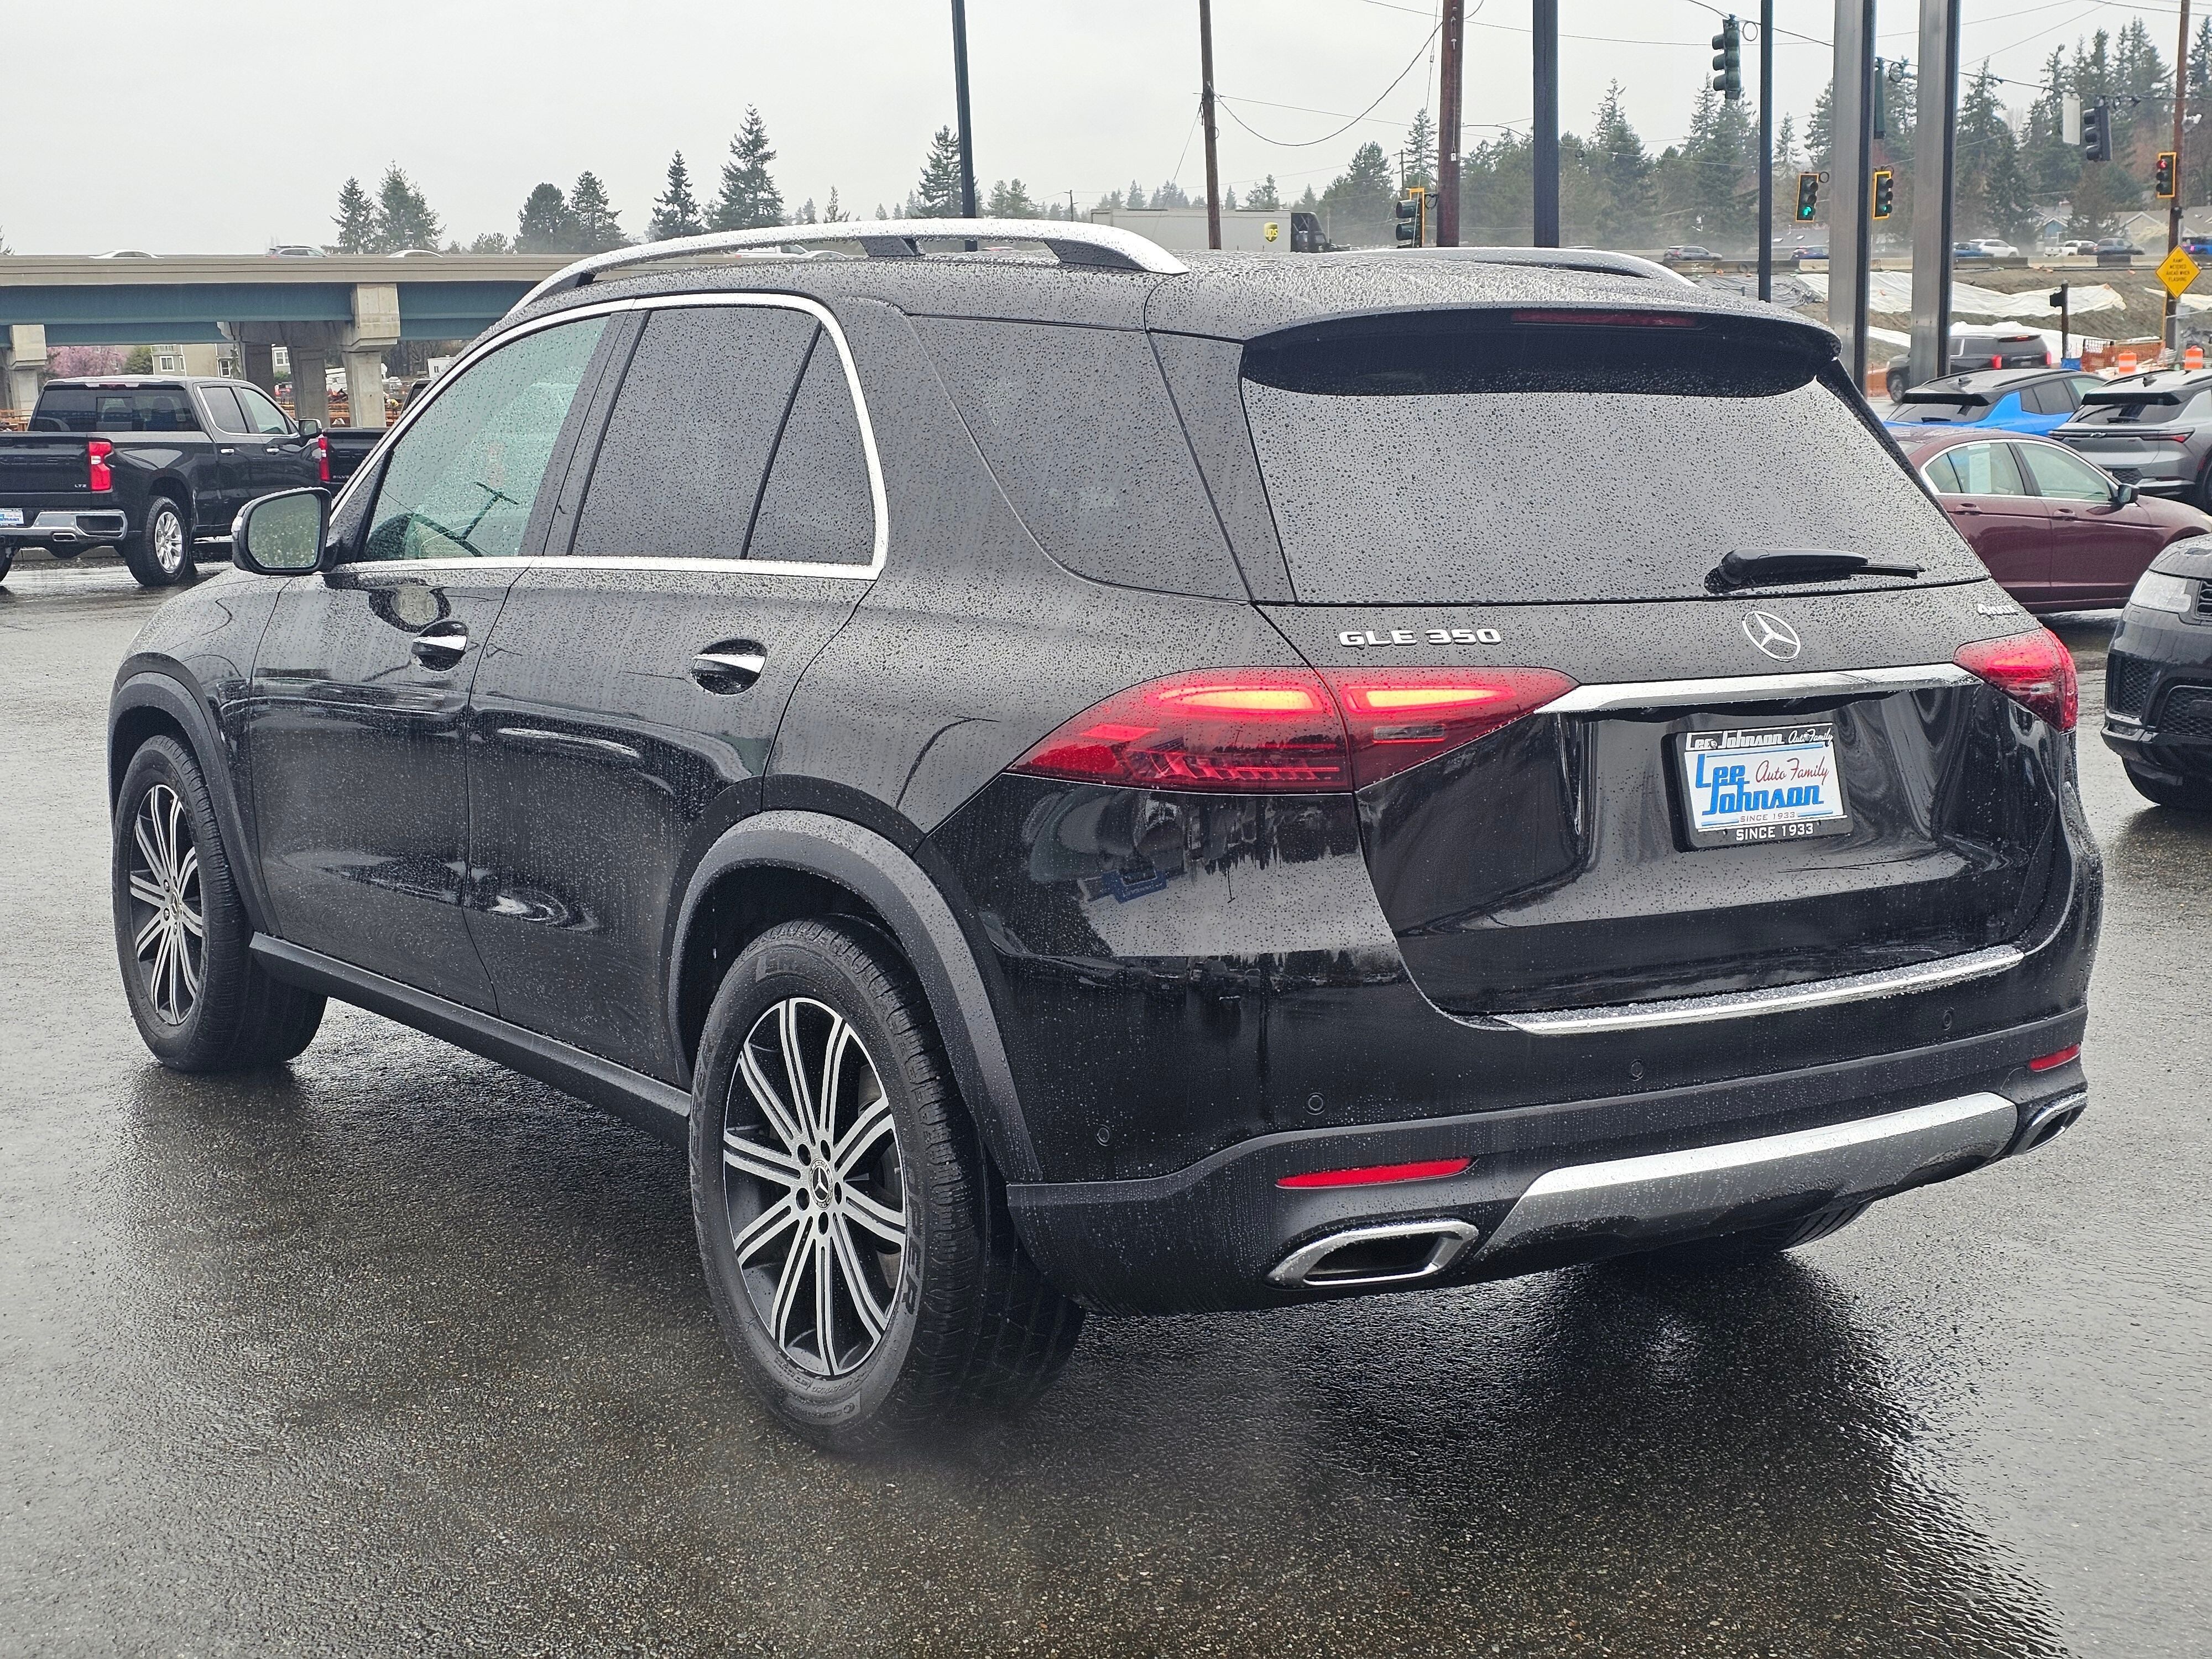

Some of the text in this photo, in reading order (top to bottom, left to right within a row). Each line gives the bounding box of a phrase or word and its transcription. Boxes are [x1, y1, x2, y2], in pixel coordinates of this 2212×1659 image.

[1265, 228, 1278, 240] ups
[1339, 628, 1502, 646] GLE 350
[1686, 727, 1834, 751] Lee Johnson Aut Family
[1695, 754, 1829, 788] Lee Auto Family
[1702, 778, 1824, 816] Johnson
[1740, 811, 1795, 822] SINCE 1933
[1736, 823, 1813, 841] SINCE 1933
